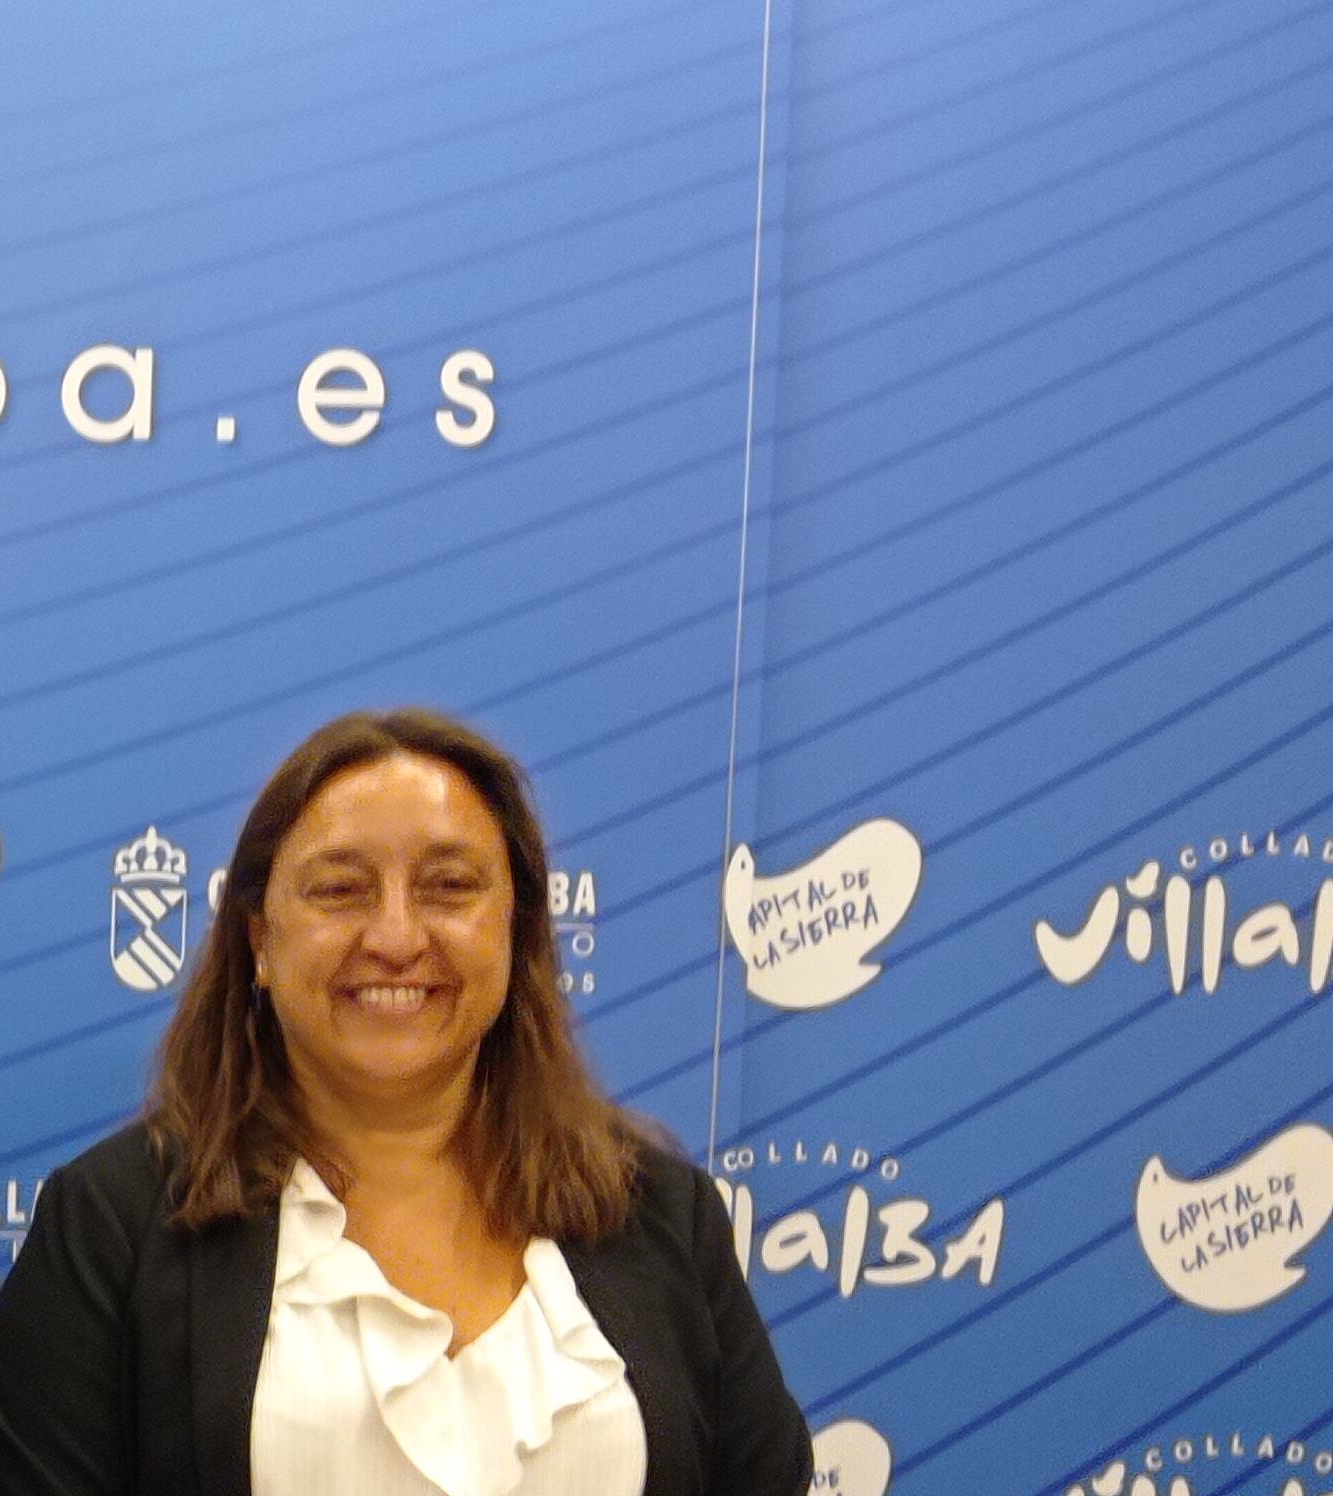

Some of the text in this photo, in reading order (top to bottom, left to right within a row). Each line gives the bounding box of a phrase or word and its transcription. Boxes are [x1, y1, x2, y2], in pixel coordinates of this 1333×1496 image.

[1180, 830, 1333, 871] COLLAD
[748, 869, 870, 935] APITAL DE
[753, 894, 879, 970] LA SIERRA
[1036, 860, 1333, 994] villal
[723, 1141, 899, 1180] COLLADO
[1160, 1173, 1295, 1244] CAPITAL DE
[1181, 1198, 1304, 1273] LA SIERRA
[1145, 1433, 1333, 1474] COLLADO
